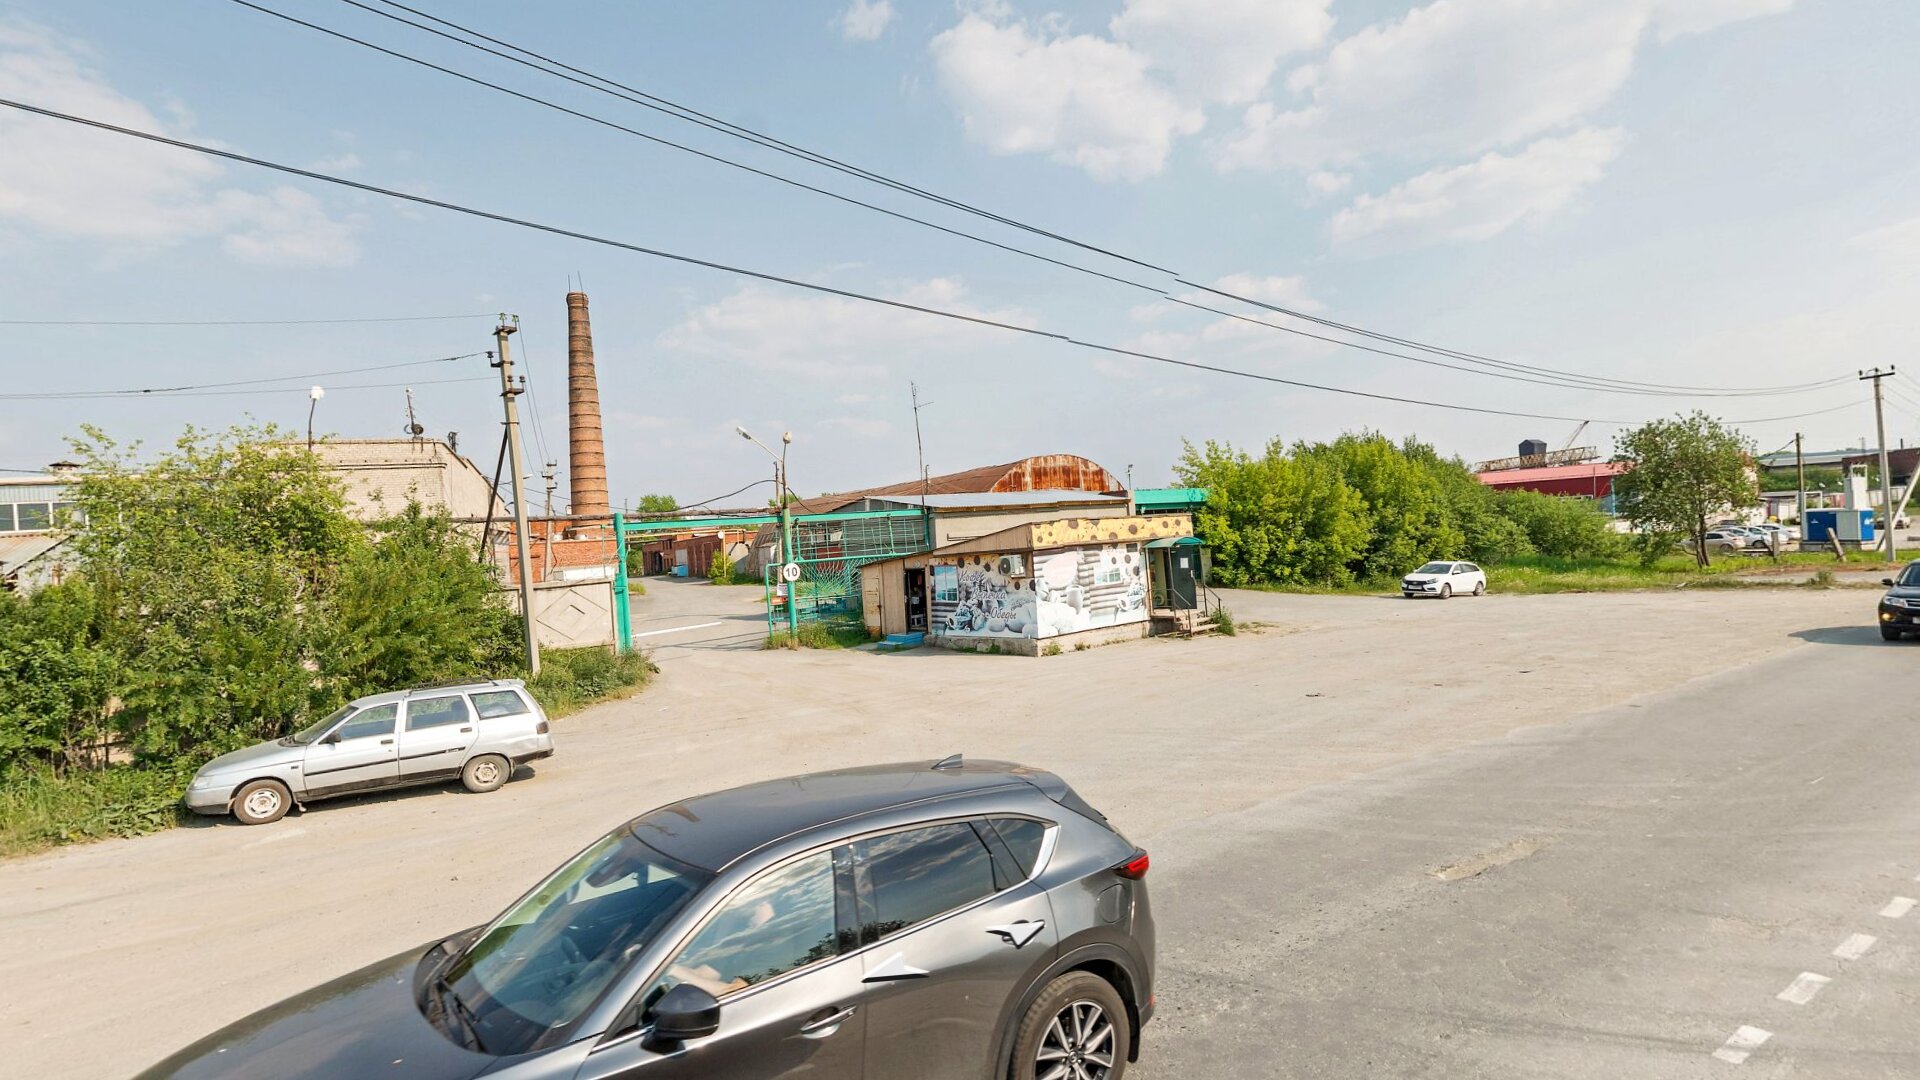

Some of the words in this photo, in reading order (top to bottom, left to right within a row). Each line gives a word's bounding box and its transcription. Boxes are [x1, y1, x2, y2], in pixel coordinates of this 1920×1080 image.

[785, 566, 798, 578] 10
[971, 588, 1006, 600] Выпечка
[990, 607, 1017, 621] Обеды
